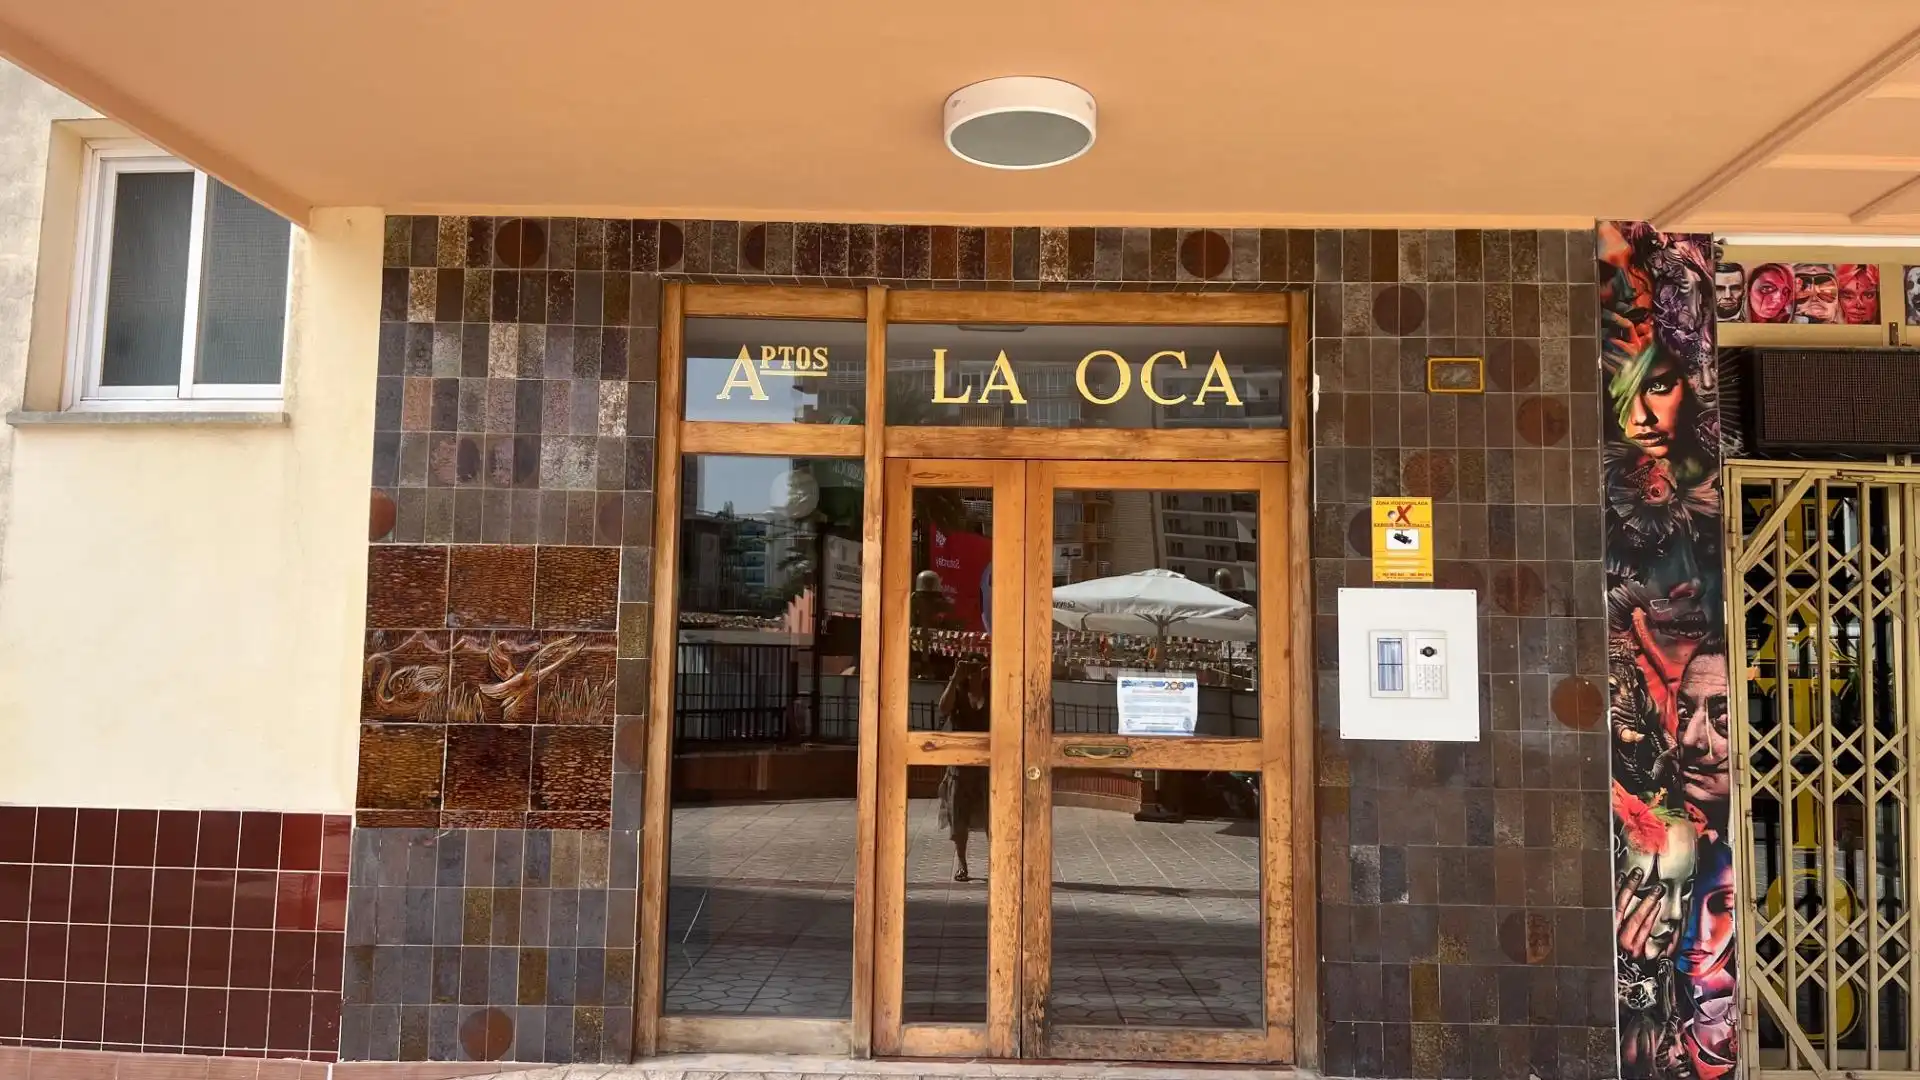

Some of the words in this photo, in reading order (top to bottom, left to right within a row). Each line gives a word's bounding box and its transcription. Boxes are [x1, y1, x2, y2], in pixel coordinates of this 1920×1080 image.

[931, 349, 1027, 404] LA
[1075, 350, 1243, 405] OCA
[1748, 498, 1863, 1044] TATTOO
